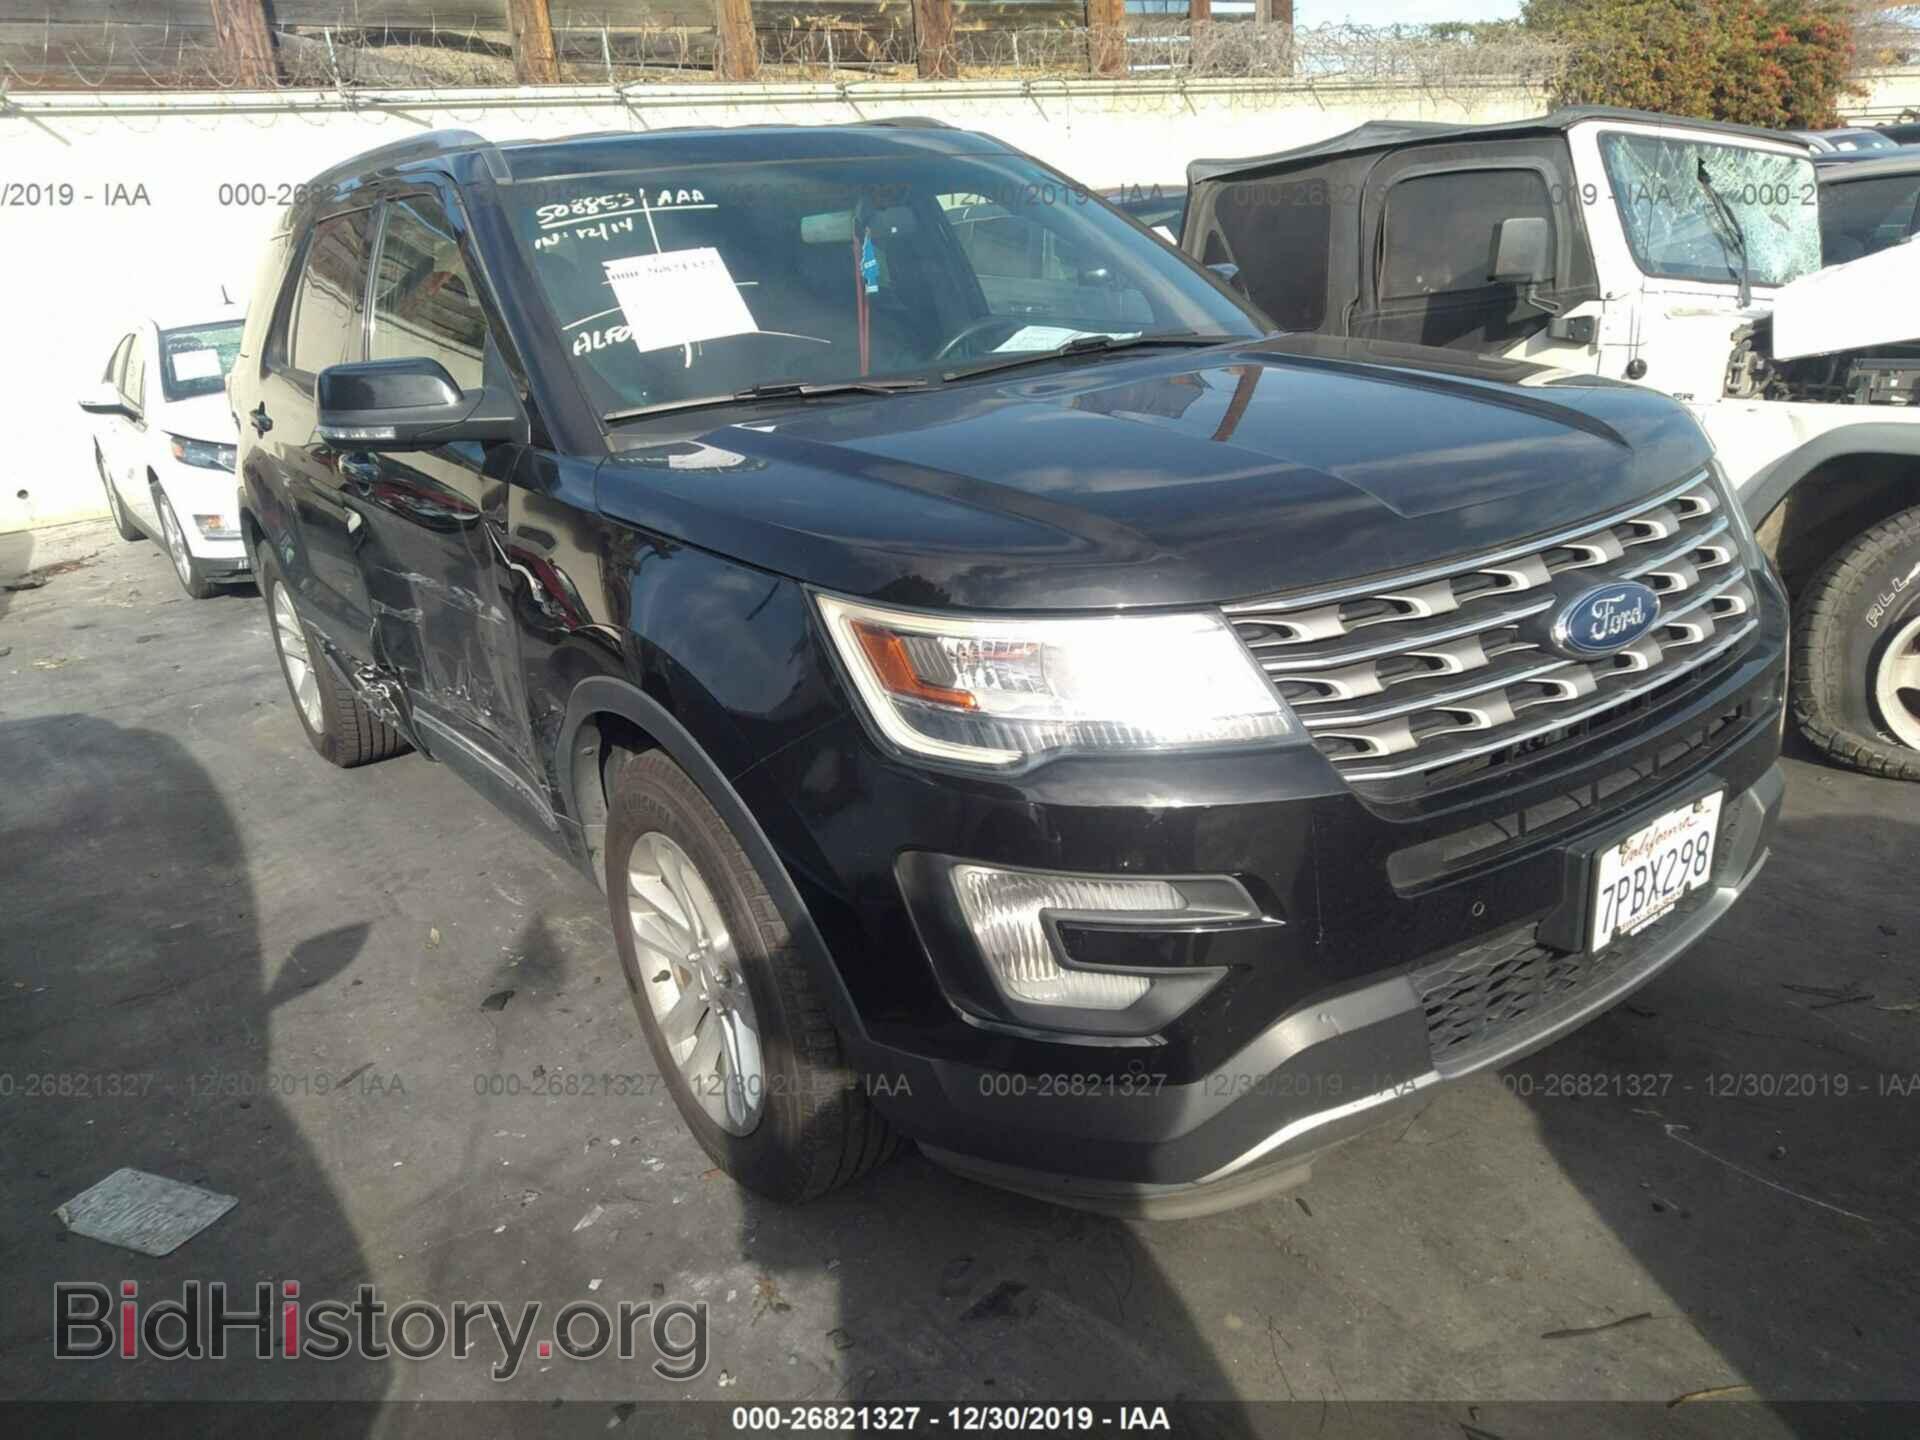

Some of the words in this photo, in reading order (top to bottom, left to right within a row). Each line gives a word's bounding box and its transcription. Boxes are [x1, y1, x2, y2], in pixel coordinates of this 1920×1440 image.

[657, 189, 705, 206] AAA
[1590, 594, 1647, 640] Ford
[1602, 830, 1710, 935] 7PBX298
